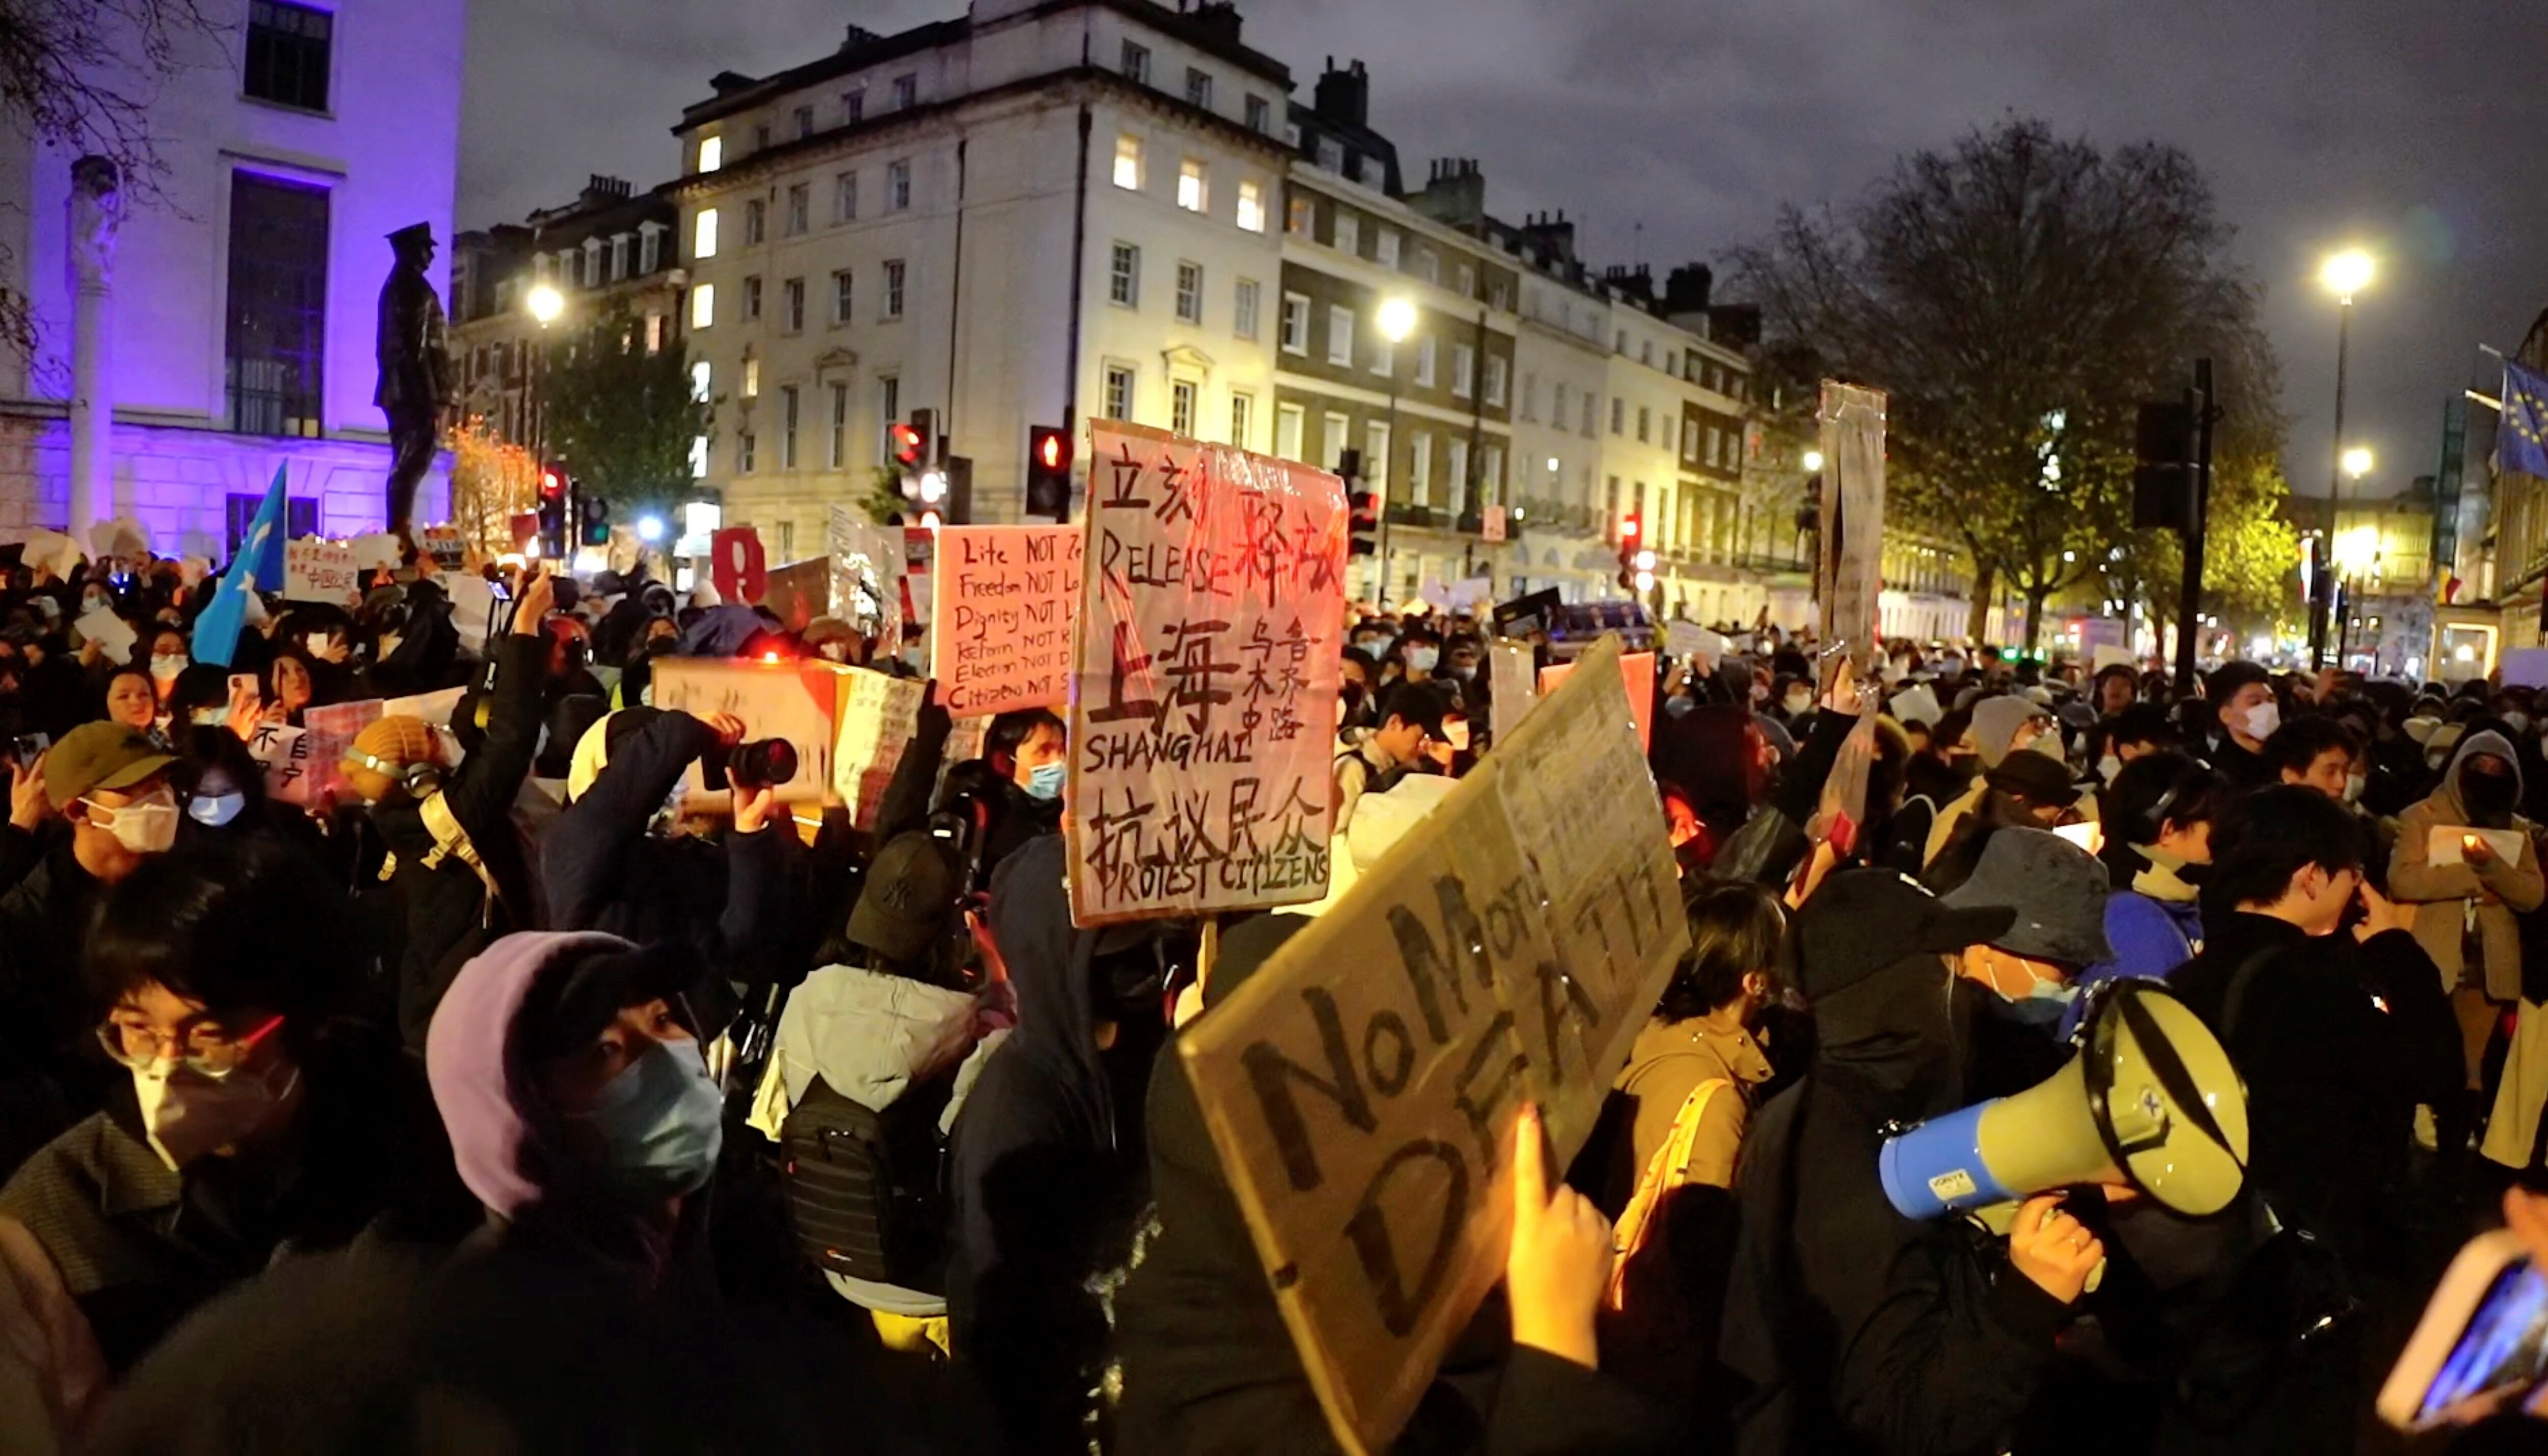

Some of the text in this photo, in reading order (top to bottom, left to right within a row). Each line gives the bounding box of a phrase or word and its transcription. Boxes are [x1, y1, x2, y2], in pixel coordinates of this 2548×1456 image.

[1102, 443, 1342, 608] 立刻 释放
[1026, 534, 1056, 564] NOT
[1101, 527, 1232, 601] RELEASE
[960, 570, 1020, 598] Freedom
[1025, 570, 1055, 593] NOT
[955, 605, 1018, 640] Dignity
[1024, 600, 1055, 623] NOT
[1023, 631, 1054, 649] NOT
[1021, 654, 1051, 670] NOT
[1088, 618, 1241, 737] 上海
[1027, 675, 1051, 694] NOT
[1084, 732, 1252, 772] SHANGHAI
[1086, 776, 1325, 867] 抗议民众
[1093, 845, 1329, 909] PROTEST CITIZENS
[1239, 986, 1415, 1192] No
